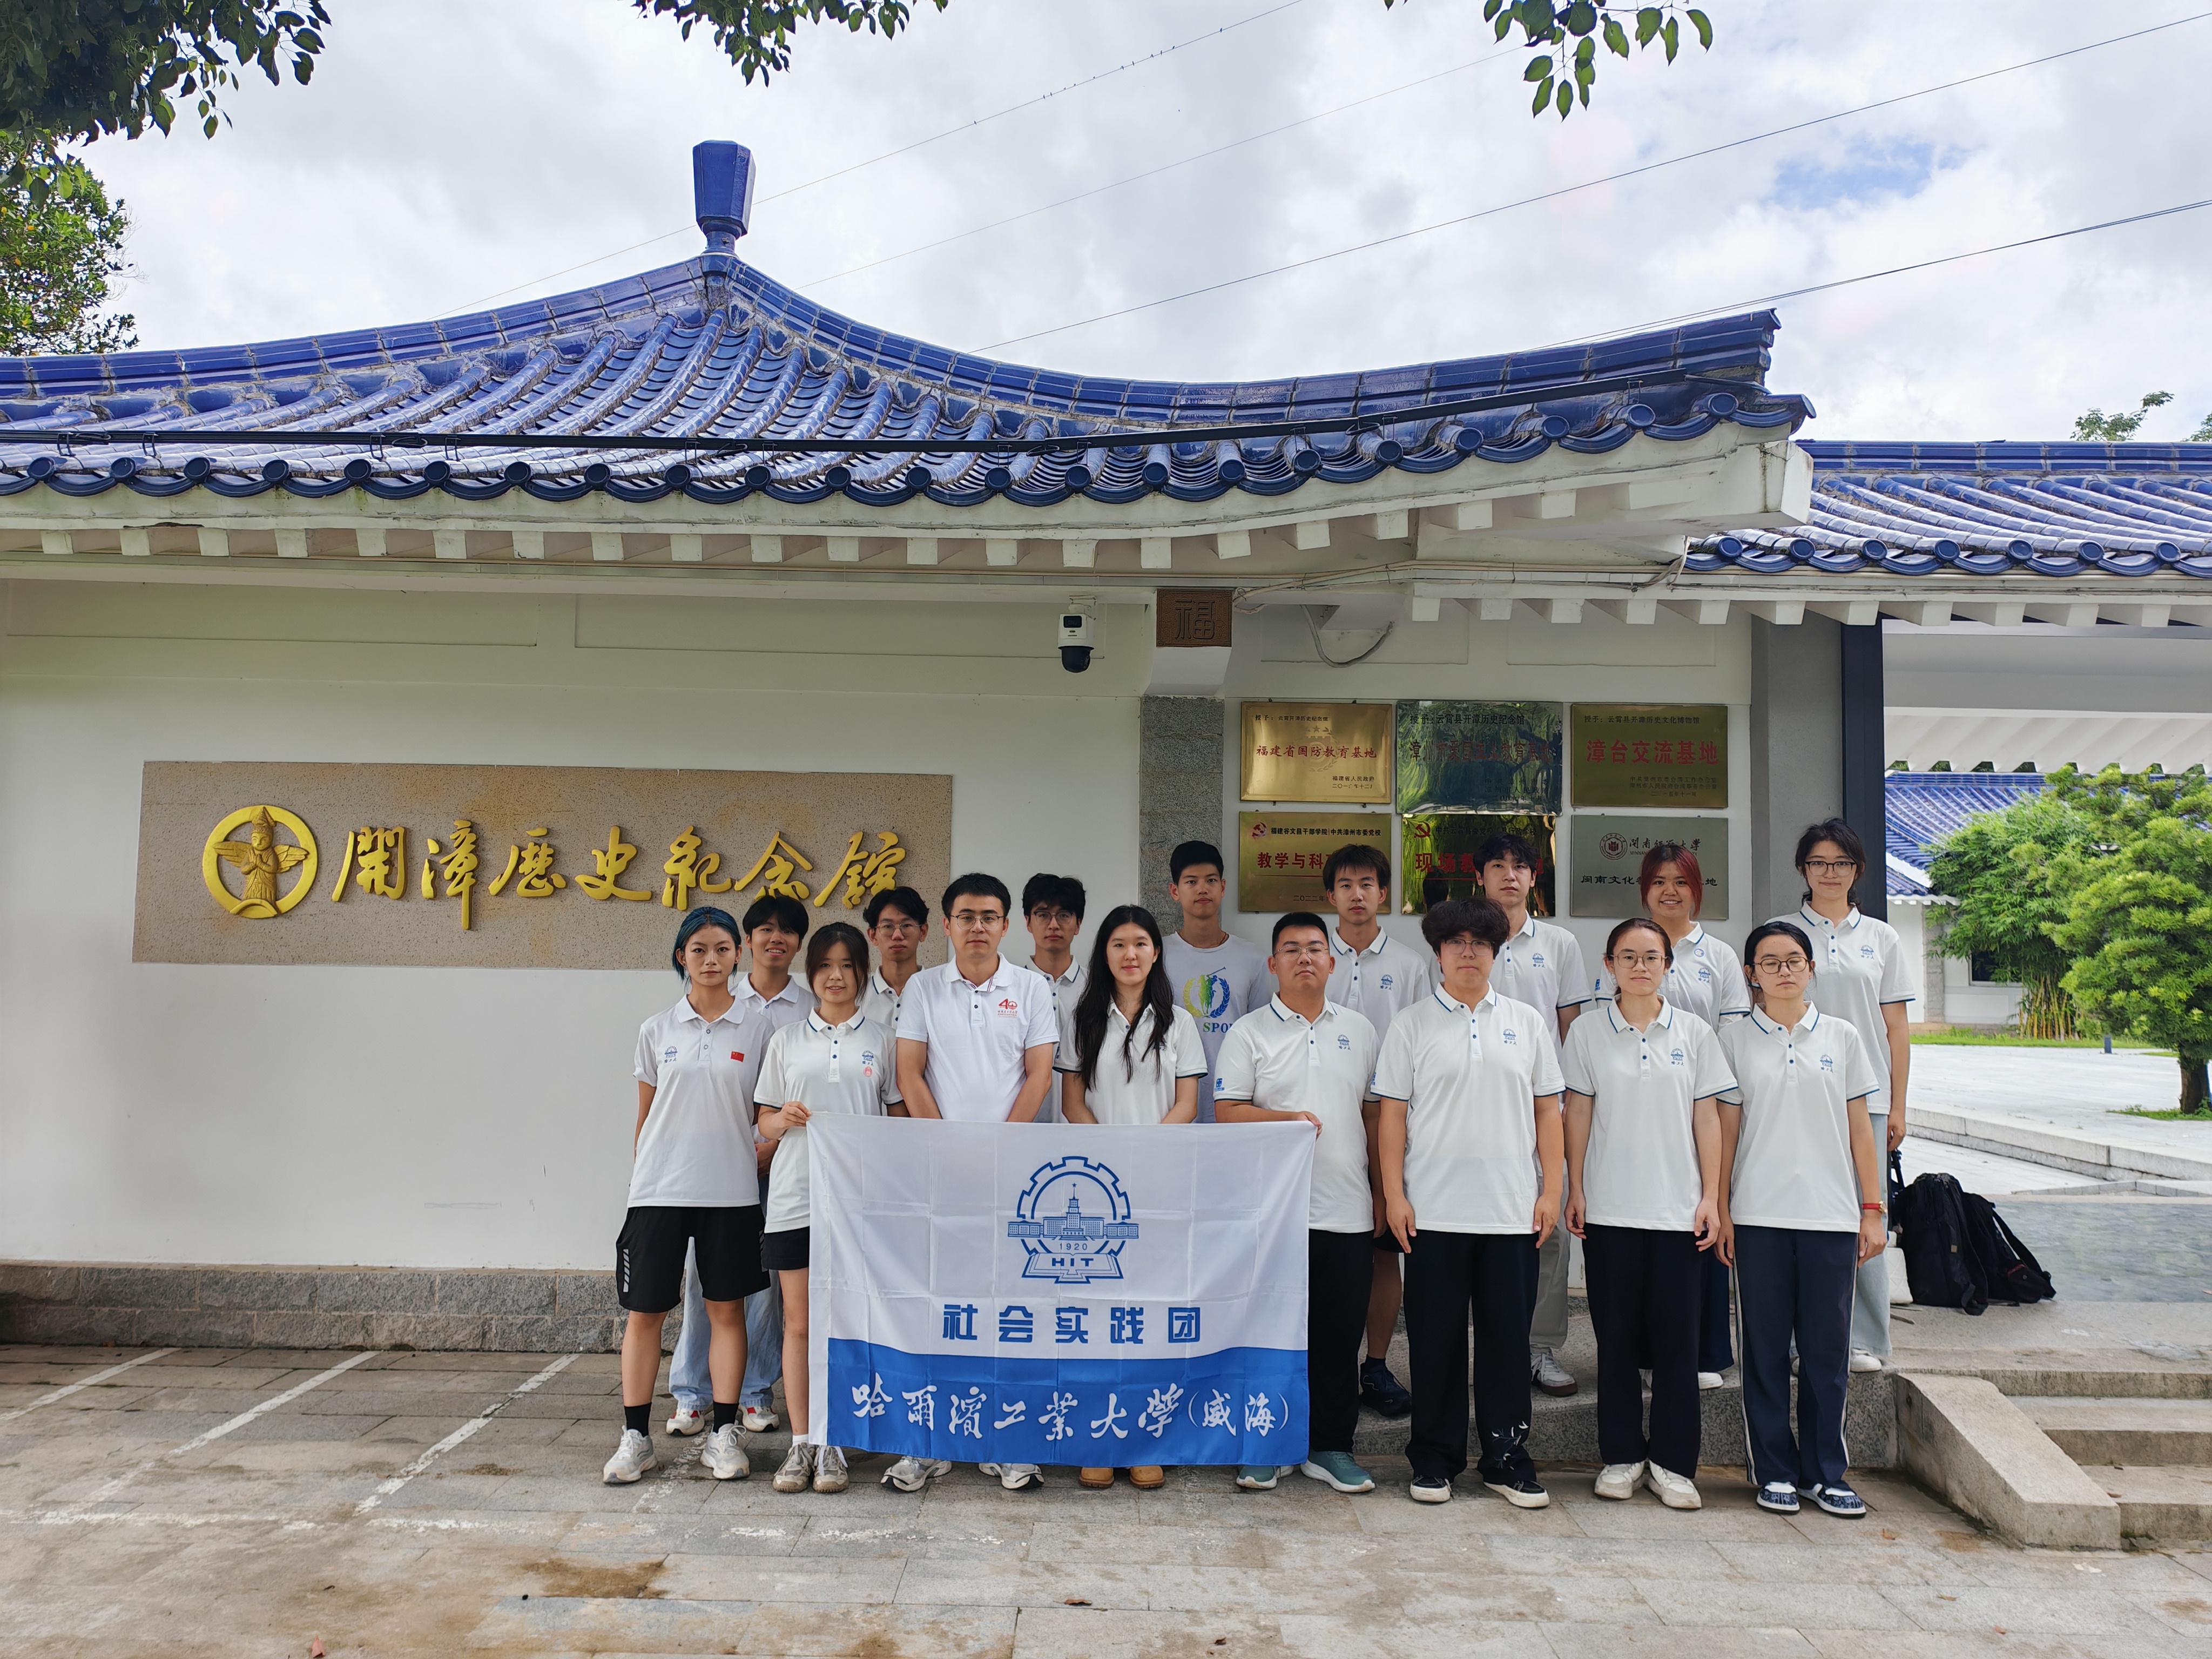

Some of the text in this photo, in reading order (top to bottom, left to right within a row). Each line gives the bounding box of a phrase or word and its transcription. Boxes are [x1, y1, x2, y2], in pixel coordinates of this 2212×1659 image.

[1175, 599, 1216, 640] 福
[1256, 745, 1377, 759] 福建省国防教育基地
[1586, 739, 1719, 766] 漳台交流基地
[1271, 827, 1381, 837] 福建谷文昌干部学院 中共漳州市委党校
[1257, 852, 1333, 870] 教学与科
[1059, 1242, 1088, 1250] 1920
[1051, 1257, 1094, 1267] HIT
[942, 1303, 1202, 1345] 社会实践团
